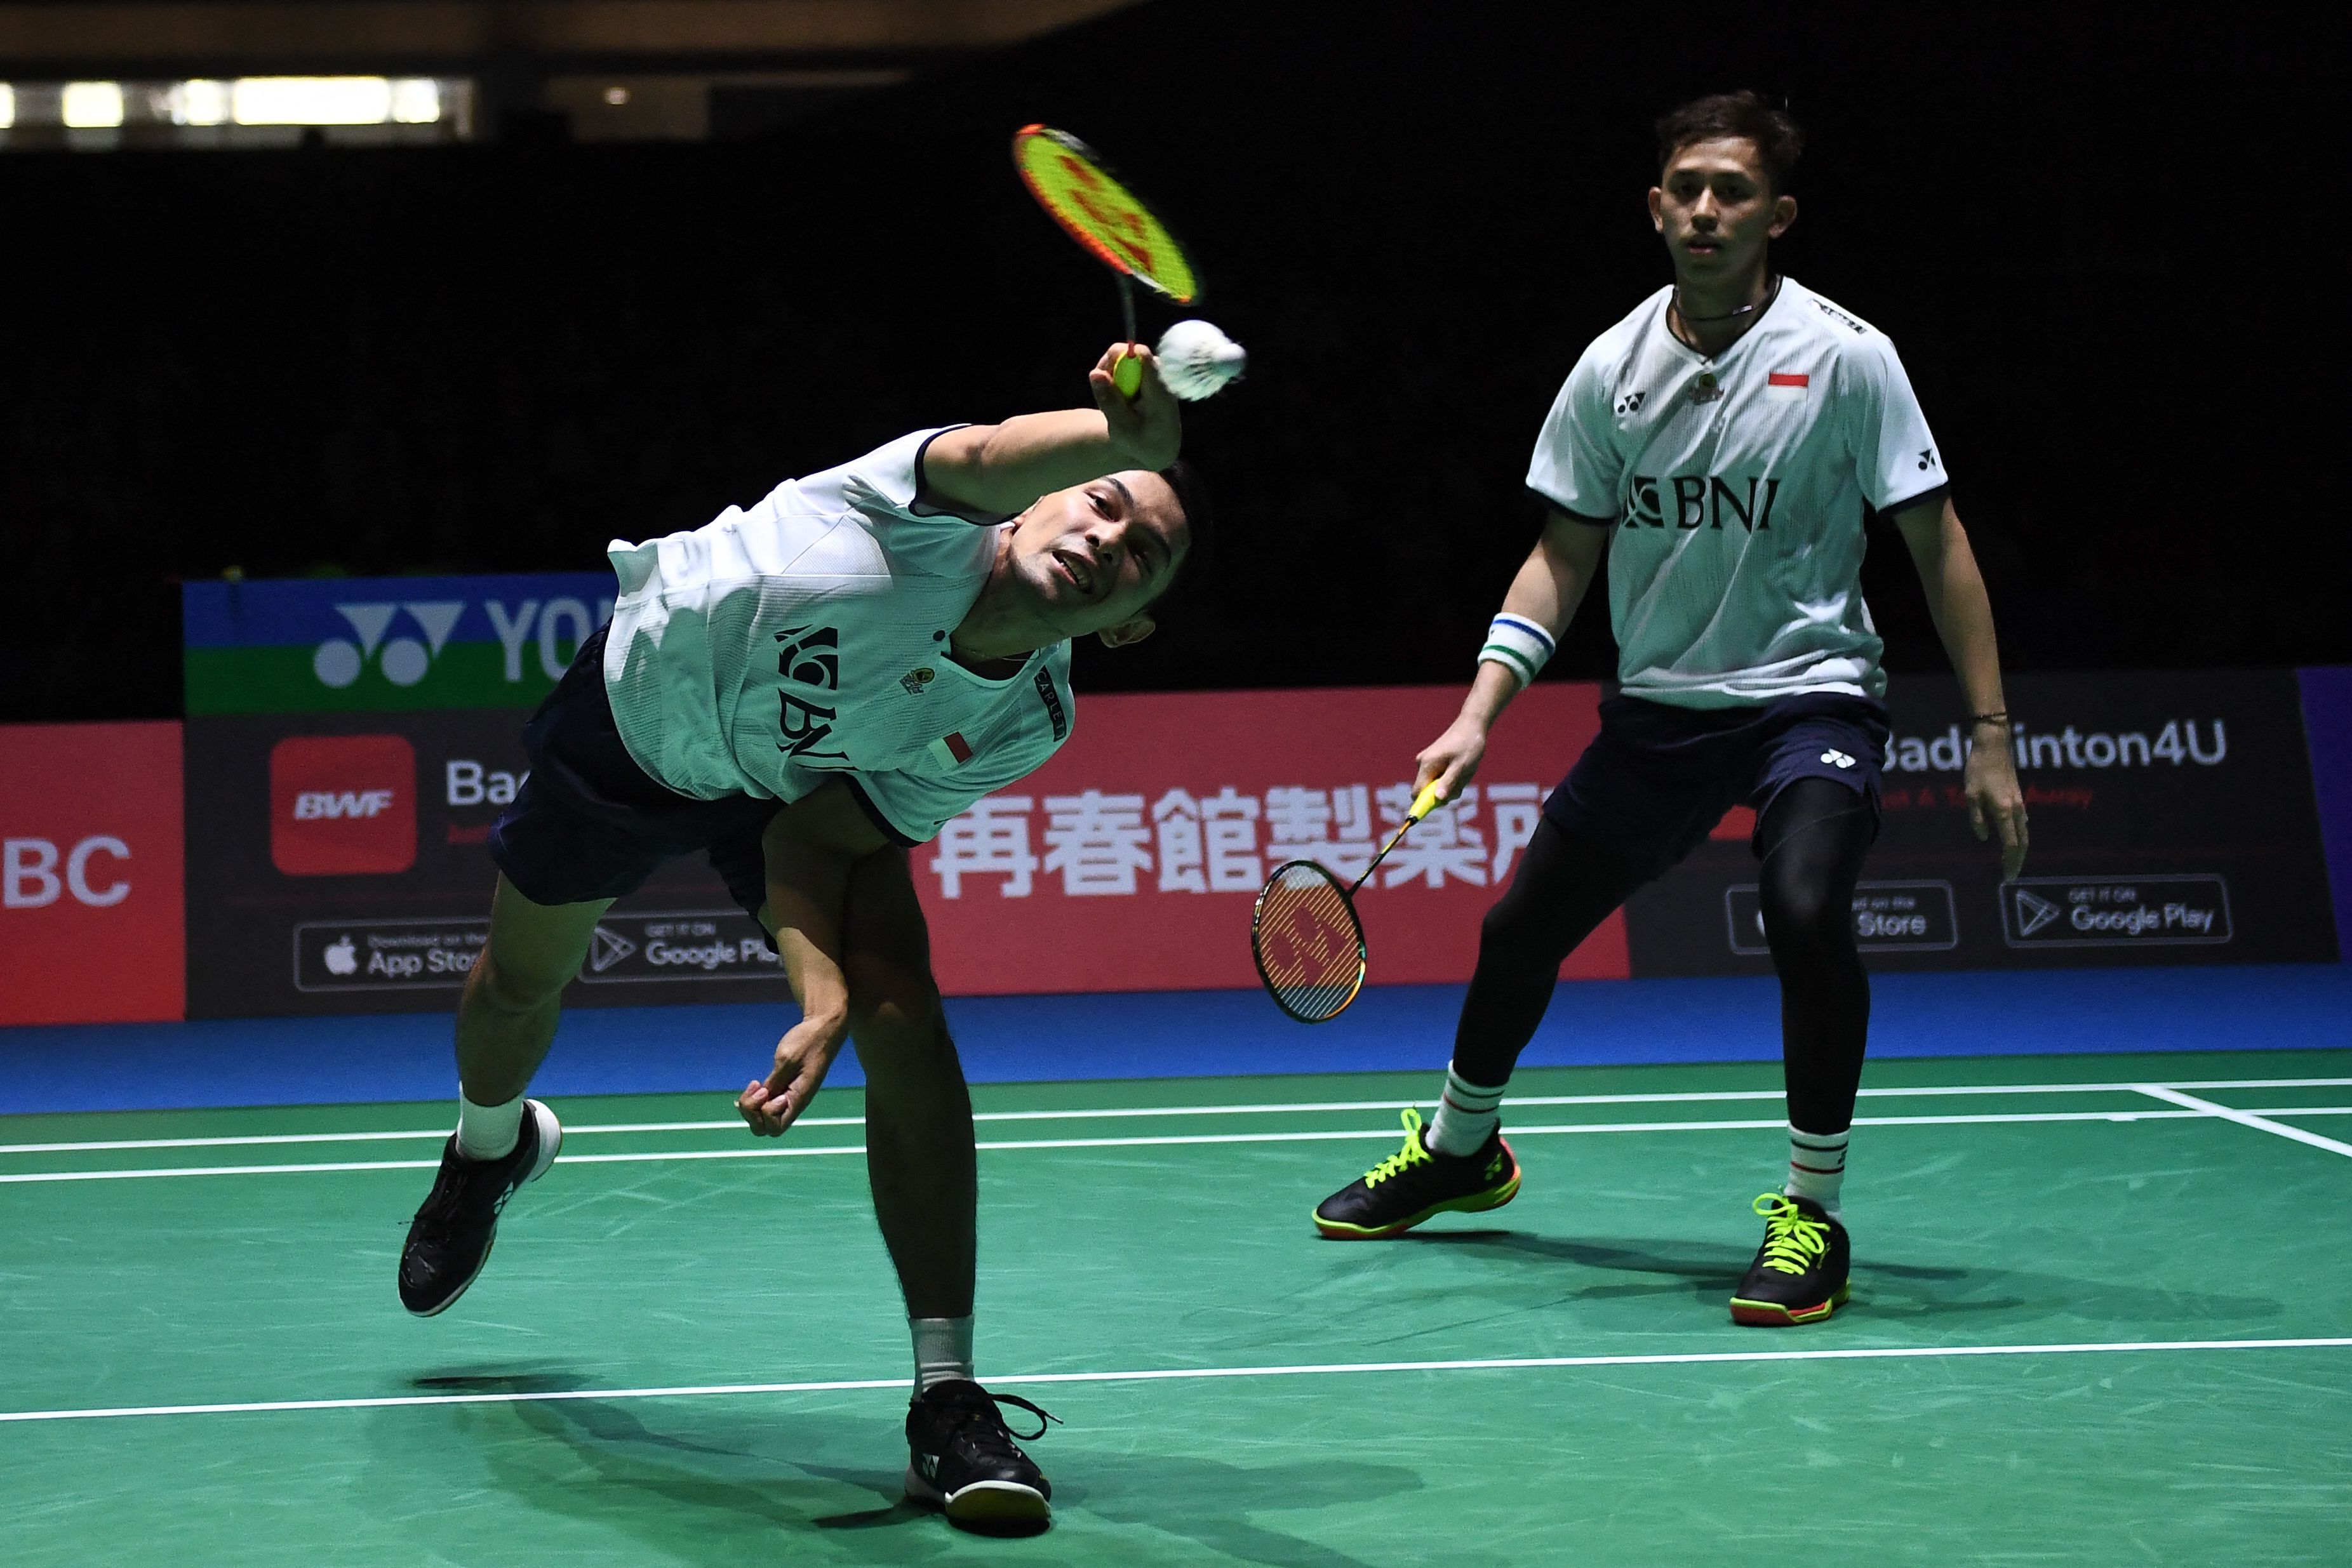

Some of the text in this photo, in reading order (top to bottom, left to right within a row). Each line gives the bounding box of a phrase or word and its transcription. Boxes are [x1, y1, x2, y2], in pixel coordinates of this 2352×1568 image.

[1672, 475, 1781, 534] BNI
[1881, 718, 2227, 773] adinton4U
[446, 759, 531, 806] Ba
[293, 790, 394, 820] BWF
[3, 835, 131, 908] BC
[1857, 910, 1927, 937] Store
[2071, 901, 2214, 936] Google Play
[367, 949, 424, 979] App
[645, 938, 783, 970] Google Pla
